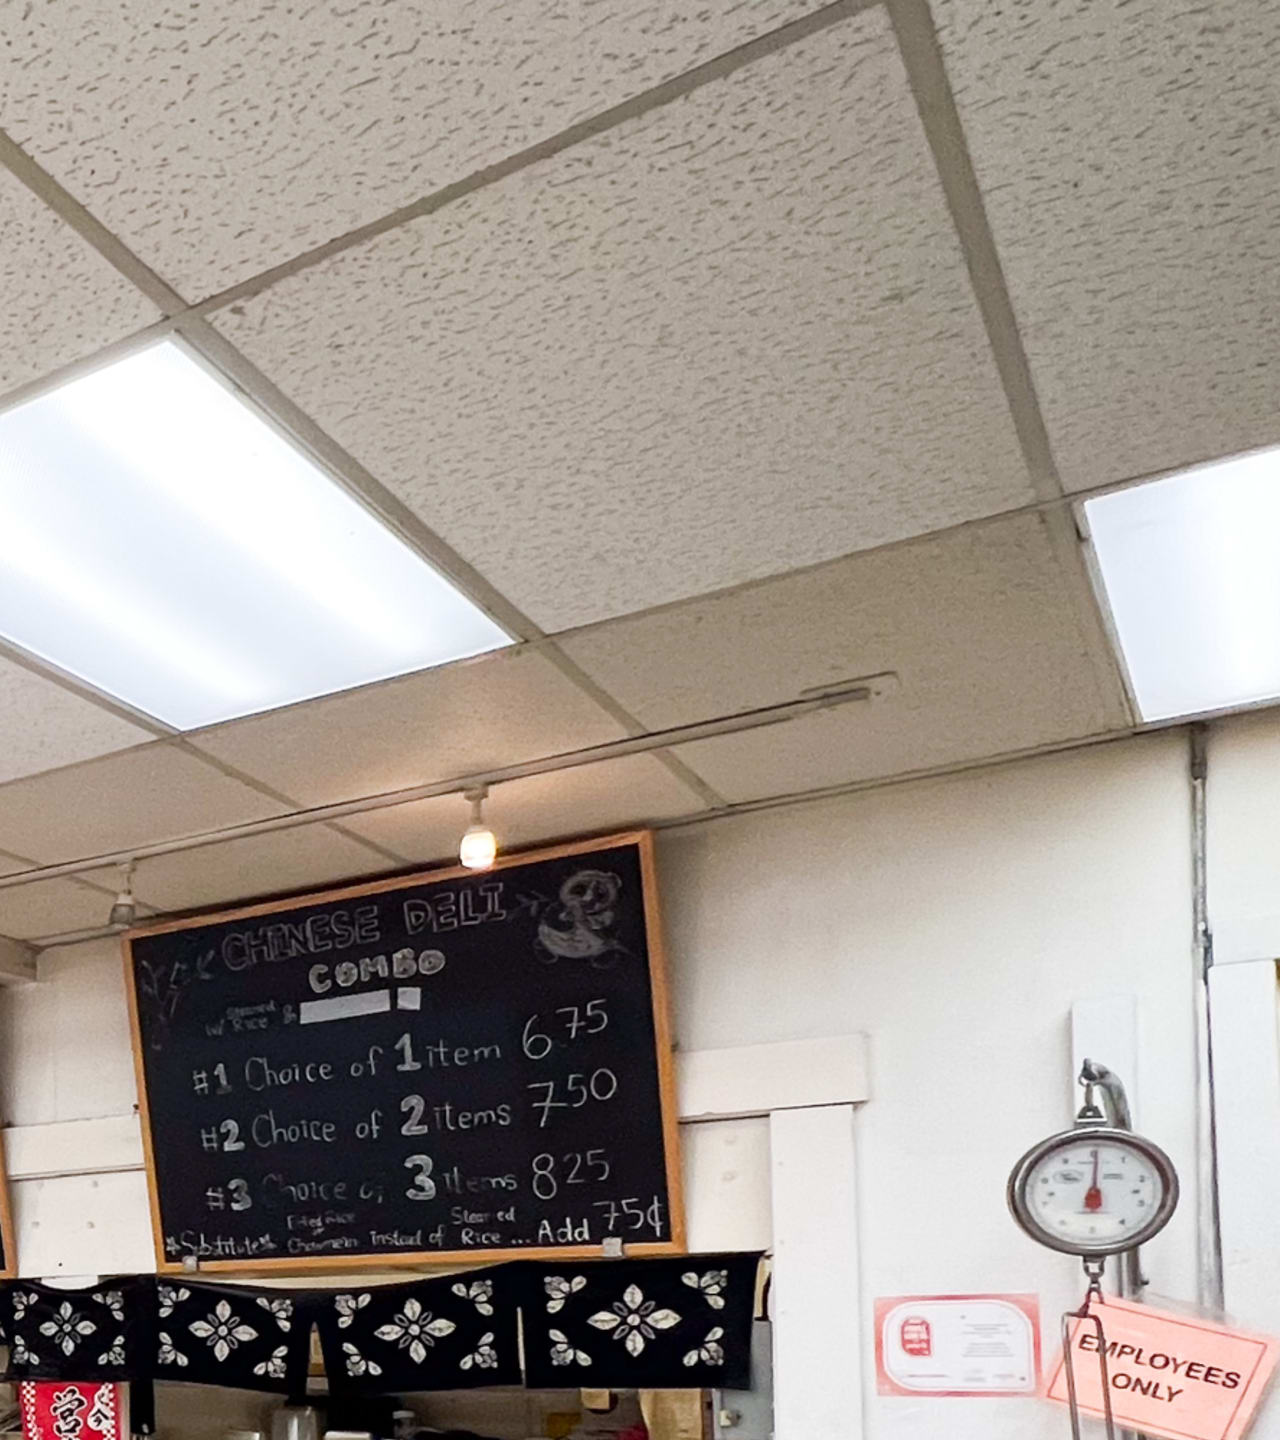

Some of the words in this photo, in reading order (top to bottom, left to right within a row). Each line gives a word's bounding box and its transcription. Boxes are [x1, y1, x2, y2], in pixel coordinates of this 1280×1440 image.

[222, 906, 380, 971] CHINESE
[404, 882, 507, 935] DELI
[309, 948, 445, 993] COMBO
[193, 1062, 232, 1095] #1
[245, 1057, 334, 1091] Choice
[350, 1047, 384, 1078] of
[394, 1033, 421, 1070] 1
[428, 1043, 501, 1068] item
[201, 1120, 245, 1152] #2
[252, 1110, 336, 1148] Choice
[356, 1110, 384, 1139] of
[400, 1095, 428, 1136] 2
[434, 1101, 511, 1131] items
[206, 1179, 252, 1211] #3
[404, 1154, 436, 1201] 3
[461, 1228, 501, 1244] Rice
[538, 1217, 590, 1243] Add
[1078, 1333, 1242, 1390] EMPLOYEES
[1111, 1372, 1184, 1404] ONLY
